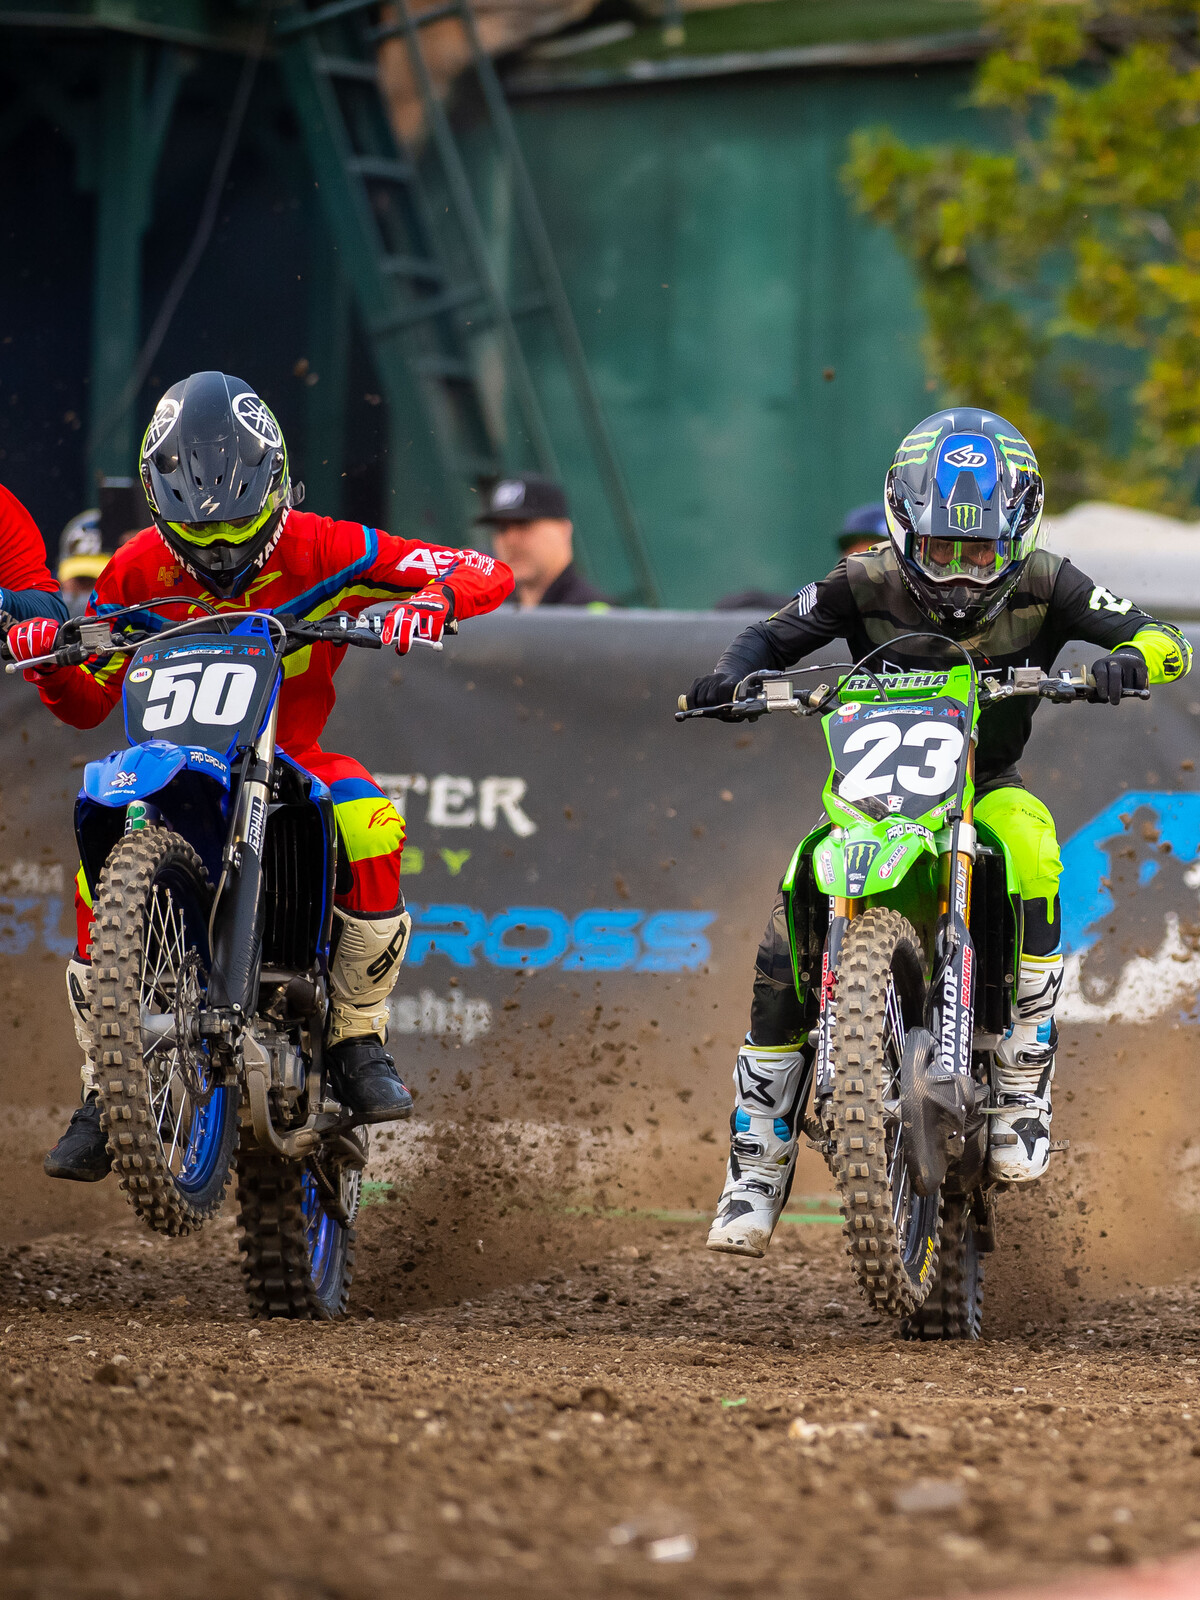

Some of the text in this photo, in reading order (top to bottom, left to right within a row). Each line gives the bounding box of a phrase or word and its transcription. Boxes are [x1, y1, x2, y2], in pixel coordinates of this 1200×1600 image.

[142, 662, 257, 732] 50
[846, 673, 950, 691] RENTHA
[190, 751, 204, 764] PRO
[838, 721, 964, 800] 23
[886, 824, 904, 841] PRO
[402, 904, 717, 972] ROSS
[961, 945, 973, 1009] BRAKING
[941, 965, 958, 1073] DUNLOP
